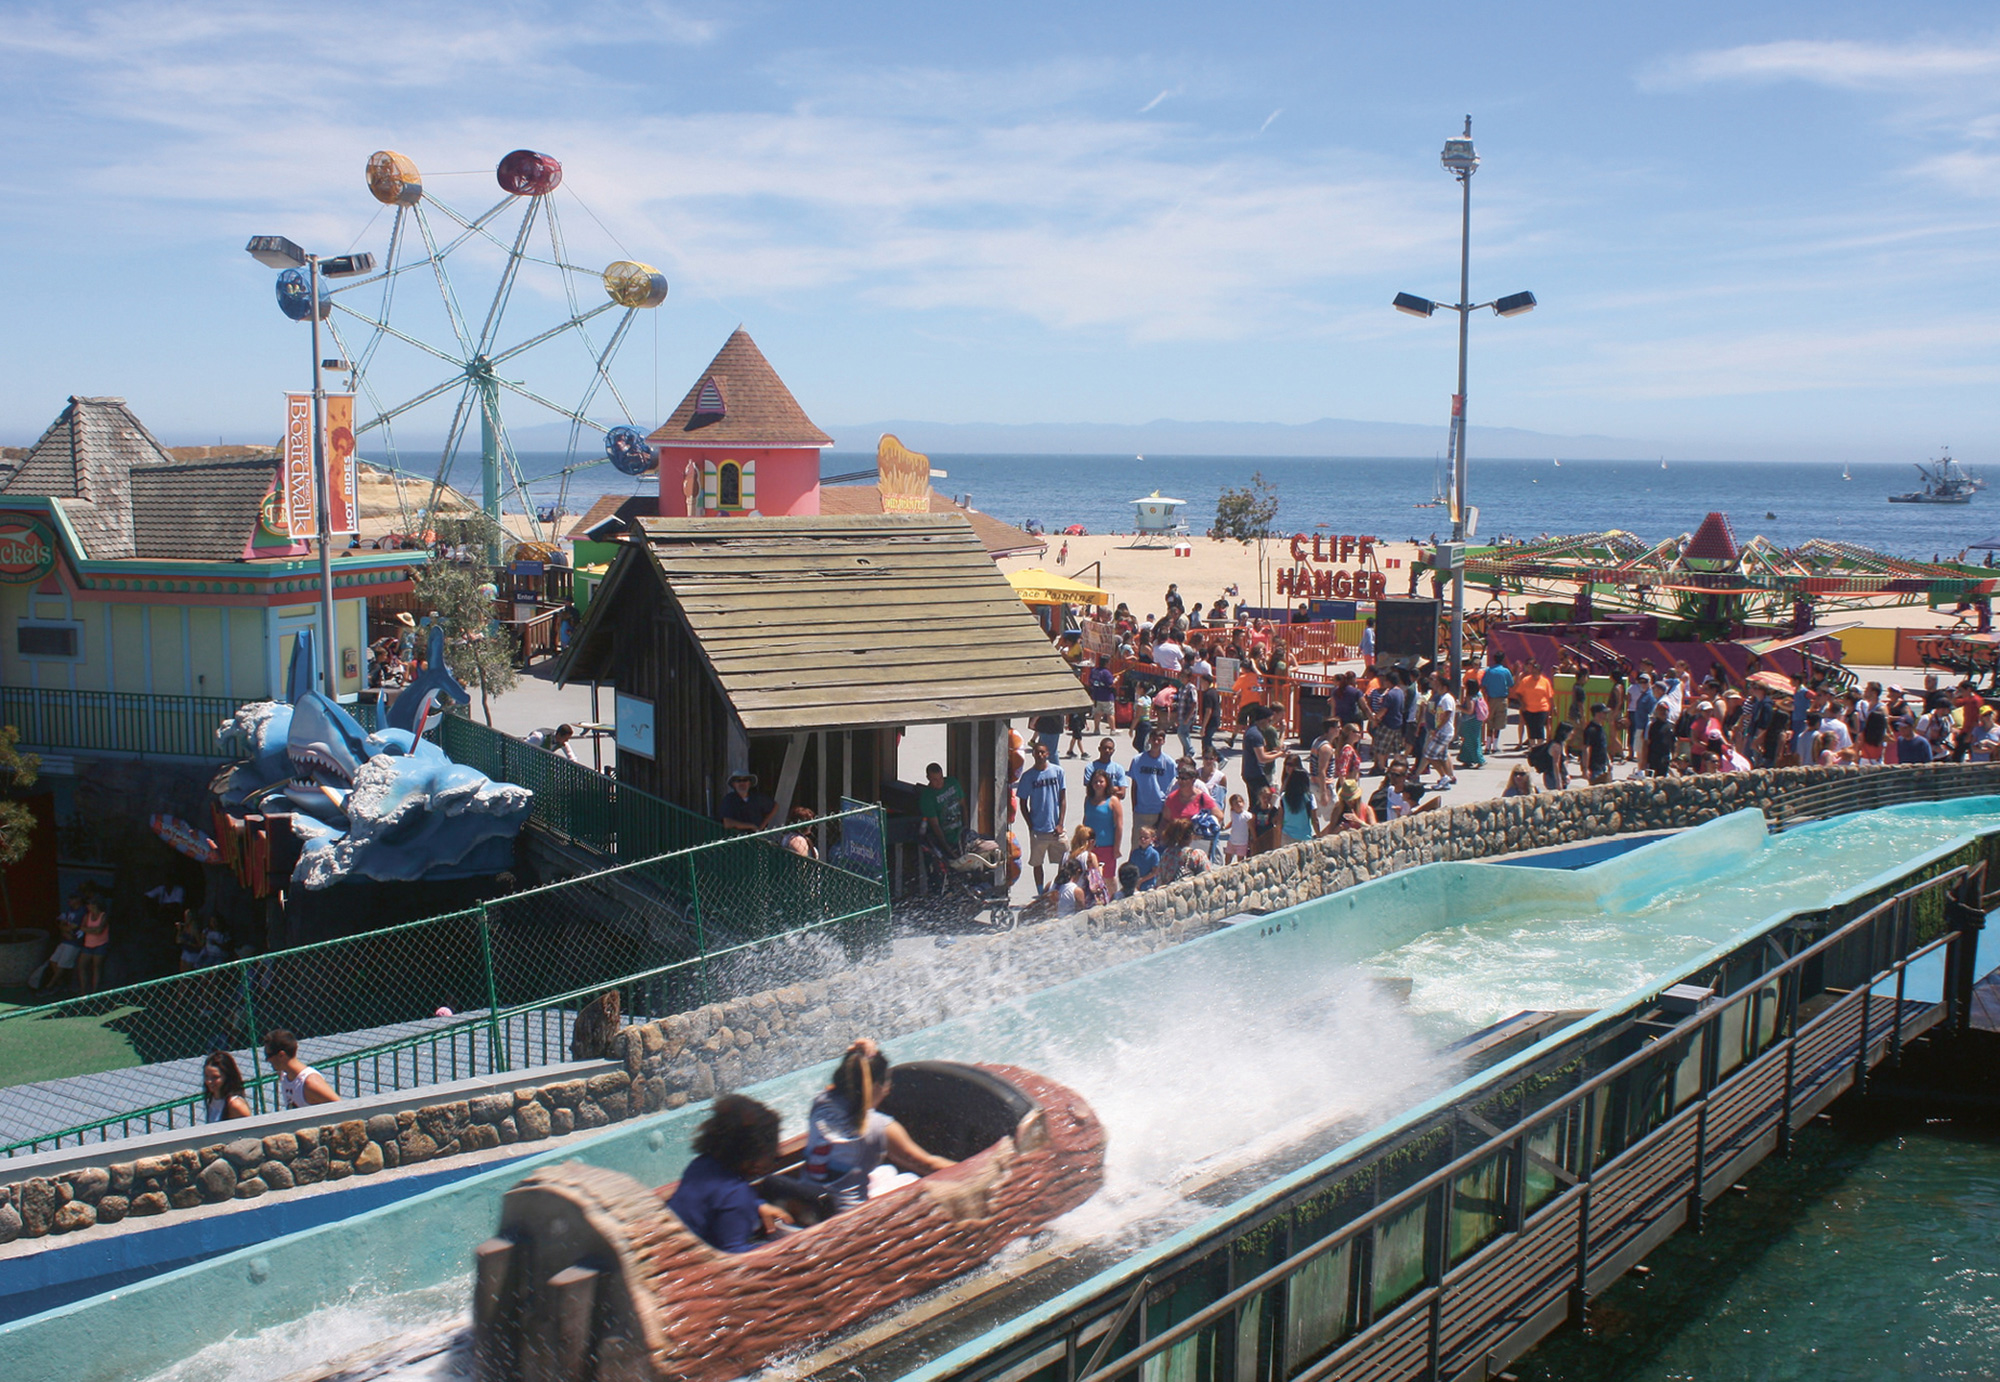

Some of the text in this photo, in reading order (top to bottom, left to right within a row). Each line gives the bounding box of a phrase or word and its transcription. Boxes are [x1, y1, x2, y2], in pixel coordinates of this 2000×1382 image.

[291, 398, 312, 534] Boardwalk
[343, 455, 354, 530] HOT RIDES
[0, 540, 52, 565] ckets
[1290, 533, 1376, 564] CLIFF
[1044, 590, 1096, 603] Painting
[1276, 567, 1387, 600] HANGER
